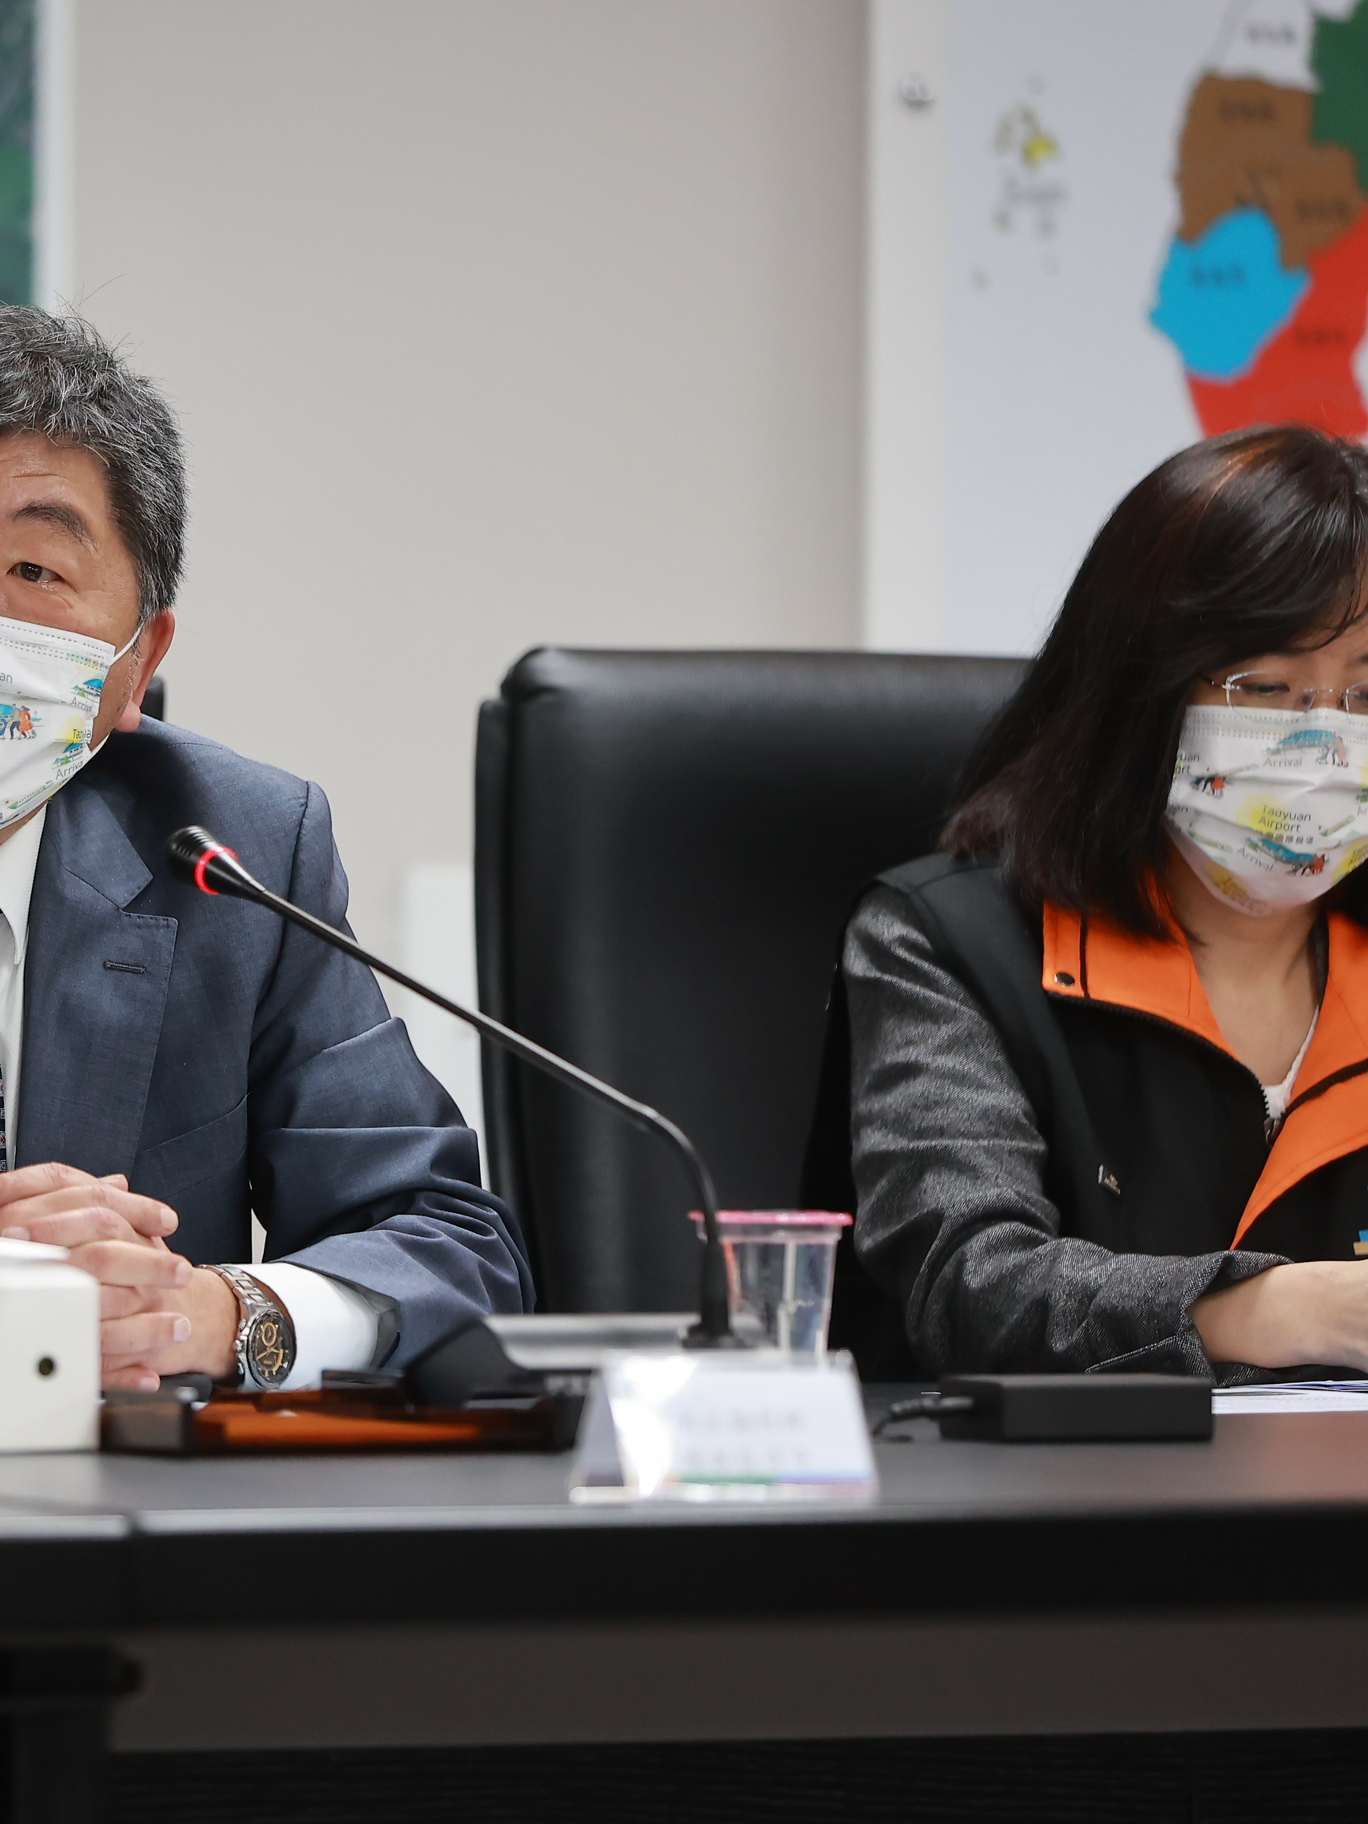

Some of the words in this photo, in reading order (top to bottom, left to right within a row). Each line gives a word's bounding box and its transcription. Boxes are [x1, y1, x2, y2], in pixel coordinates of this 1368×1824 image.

[1263, 757, 1302, 768] Arrival
[1263, 805, 1312, 822] Taoyuan
[1258, 816, 1301, 833] Airport
[1236, 846, 1274, 872] Arrival
